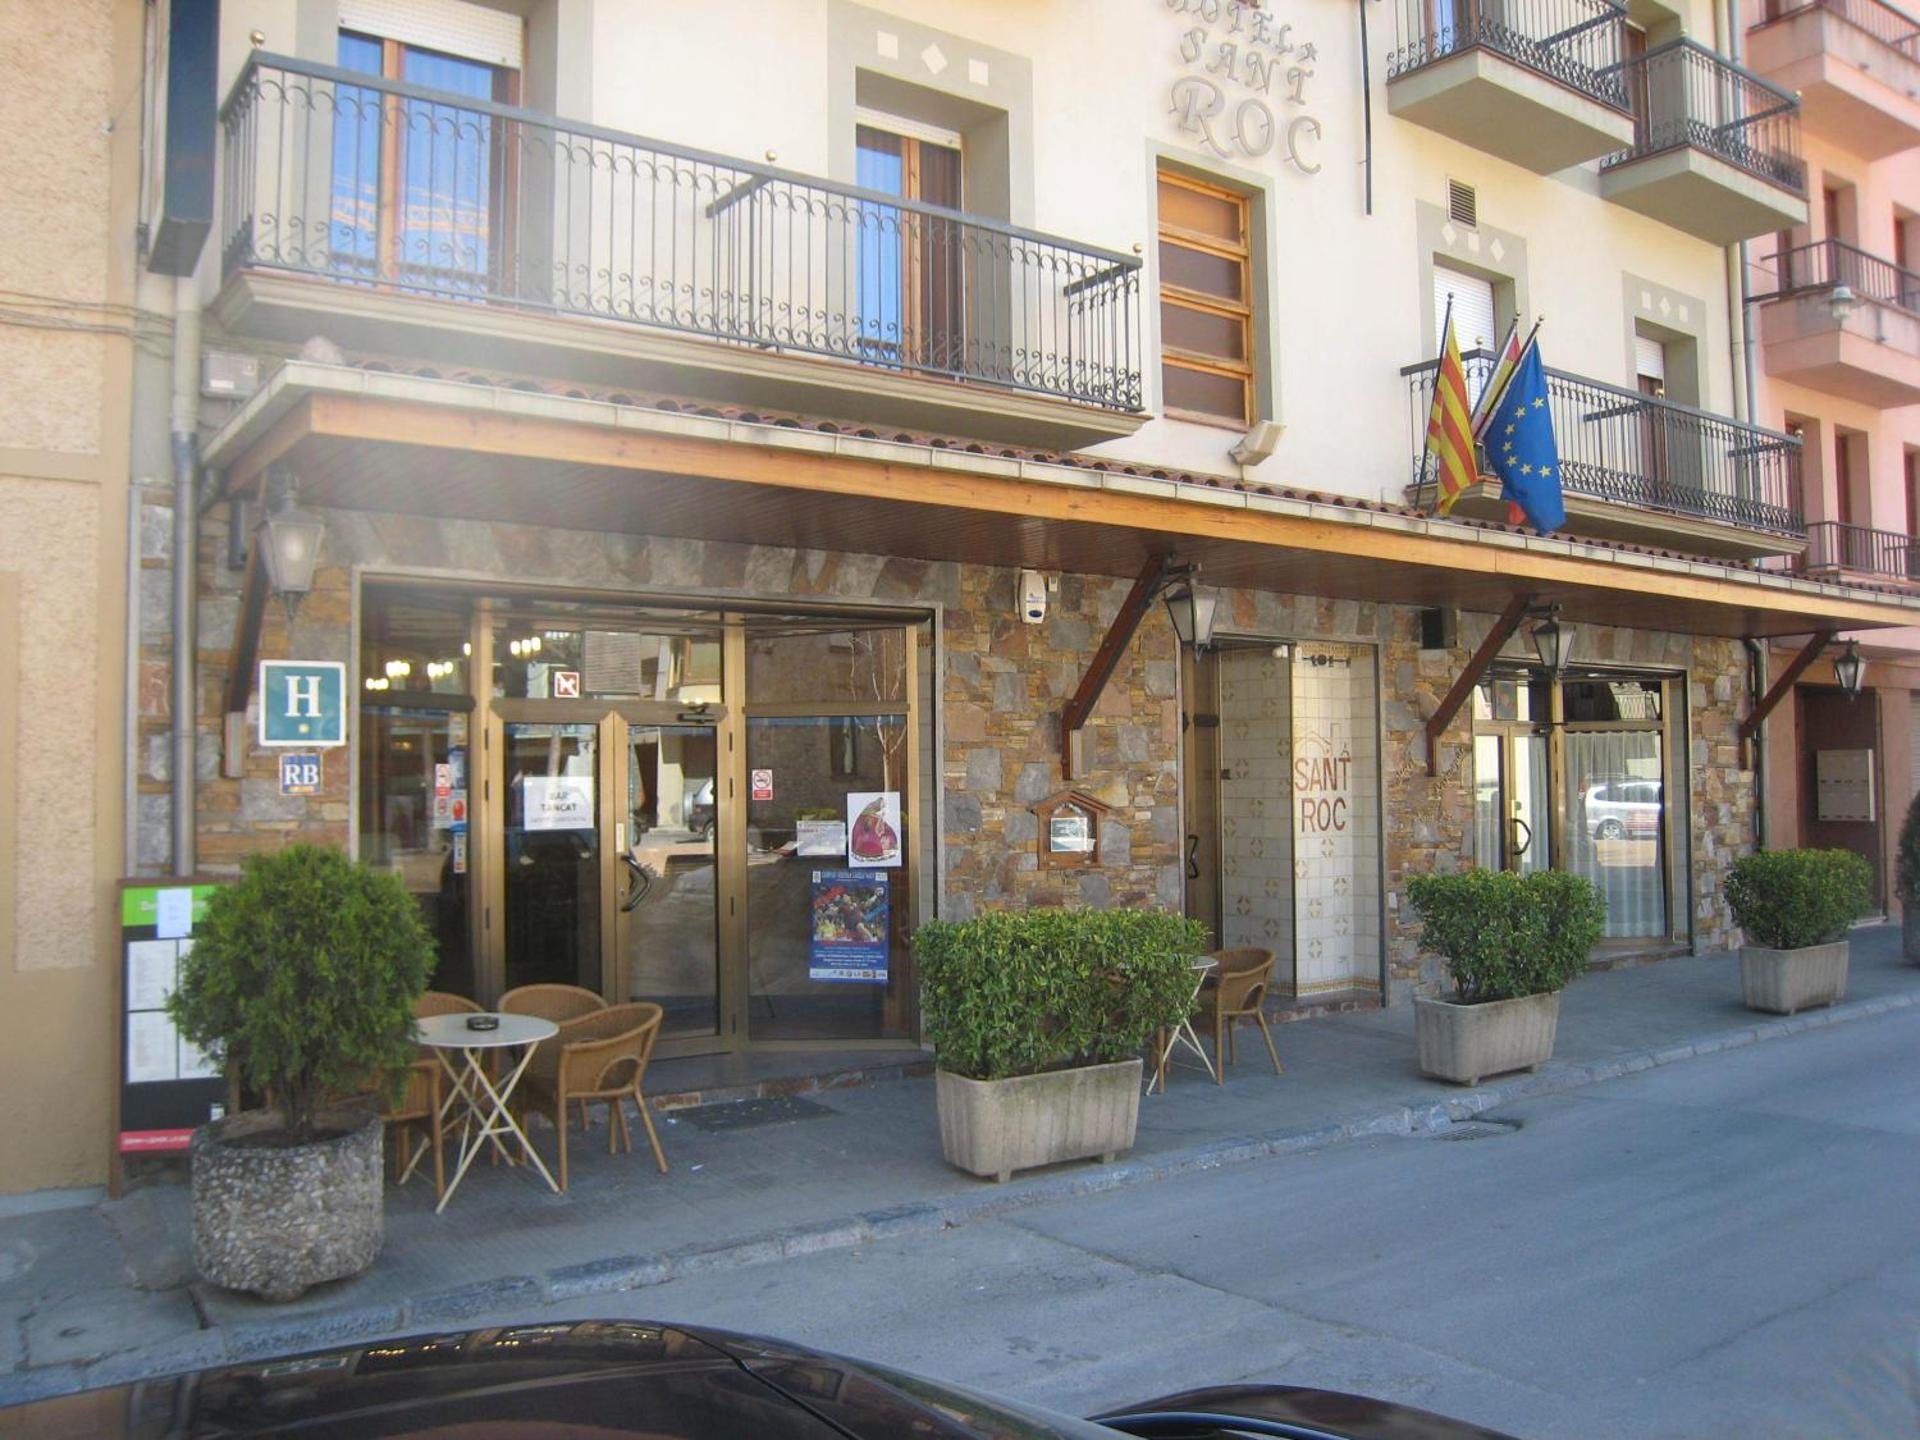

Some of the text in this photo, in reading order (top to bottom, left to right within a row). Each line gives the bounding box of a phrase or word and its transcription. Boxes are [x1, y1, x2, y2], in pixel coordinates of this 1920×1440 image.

[1179, 27, 1314, 105] SANT
[1170, 75, 1322, 175] ROC
[284, 675, 322, 717] H
[284, 763, 319, 785] RB
[1294, 757, 1351, 792] SANT
[1301, 797, 1347, 832] ROC
